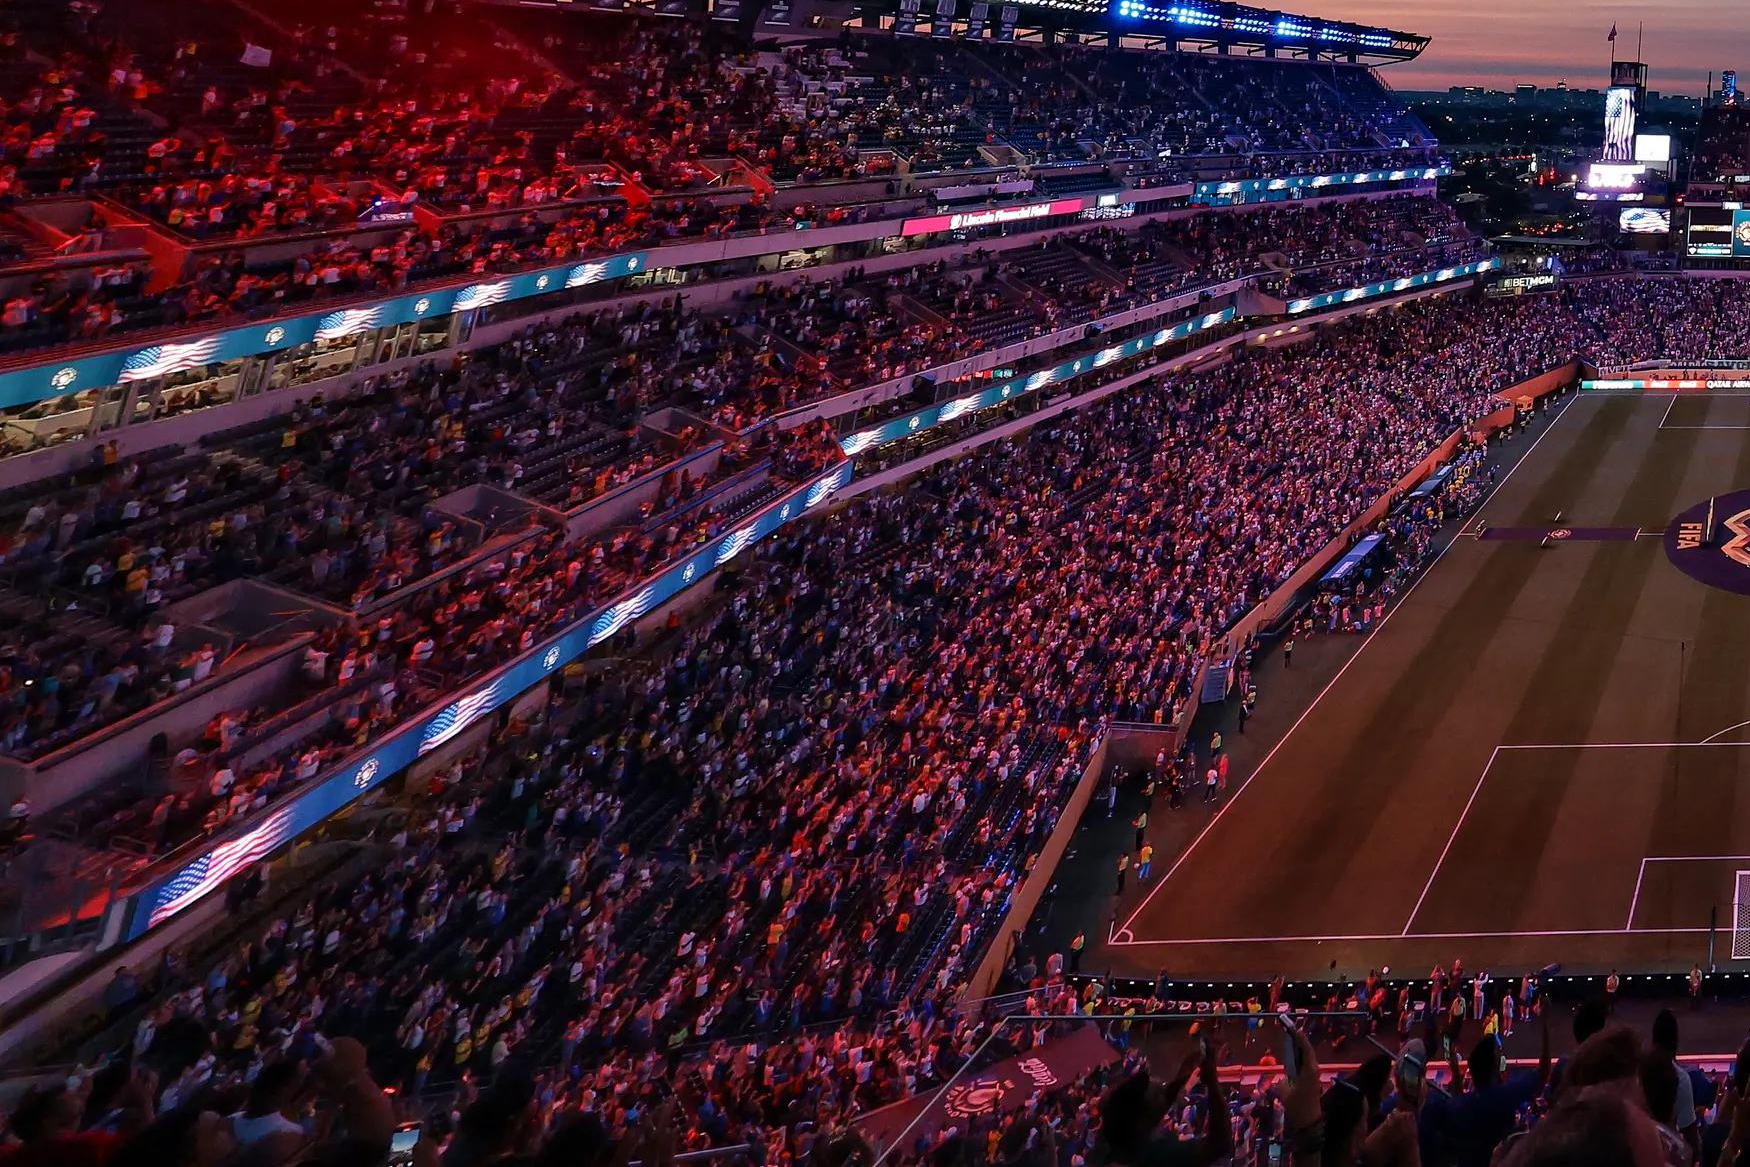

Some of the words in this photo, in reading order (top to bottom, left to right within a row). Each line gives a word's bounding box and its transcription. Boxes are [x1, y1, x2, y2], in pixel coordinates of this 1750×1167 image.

[962, 212, 994, 227] Lincoln
[994, 206, 1030, 224] Financial
[1030, 204, 1051, 218] Field
[1707, 381, 1731, 389] QATAR
[1676, 522, 1703, 550] FIFA
